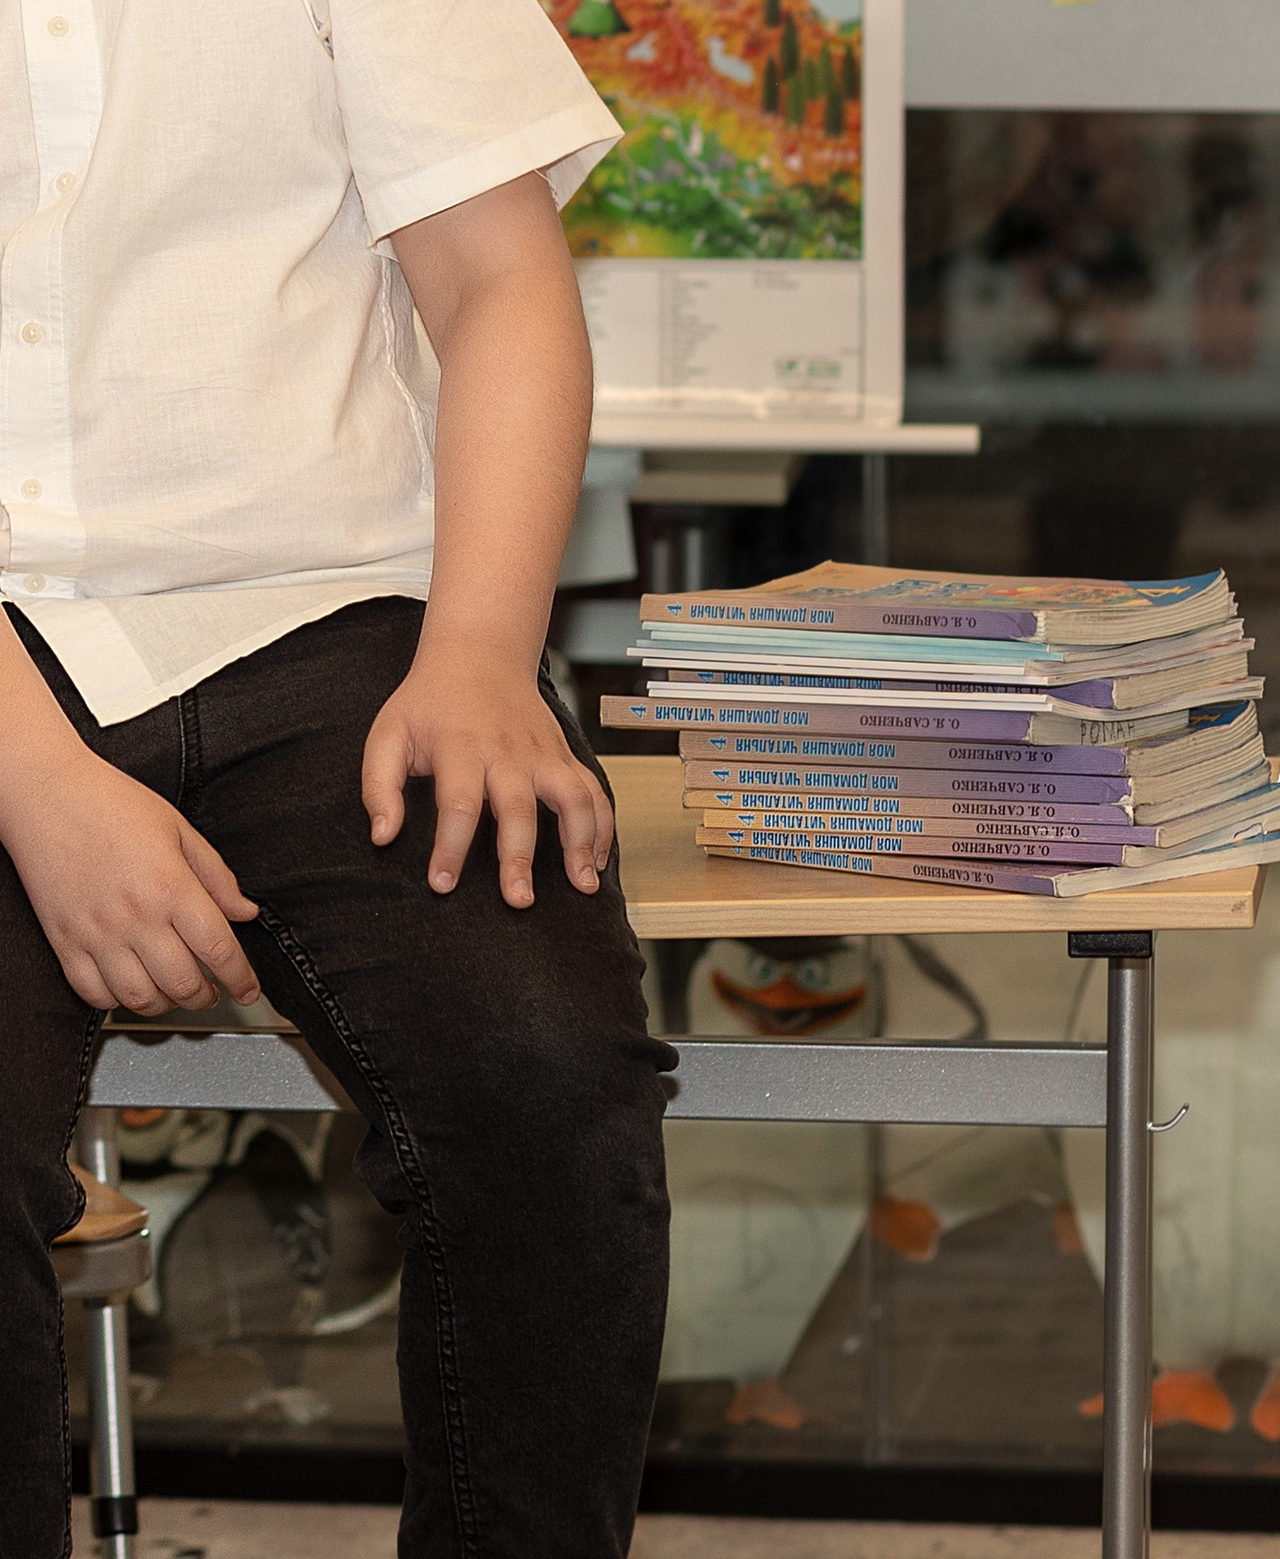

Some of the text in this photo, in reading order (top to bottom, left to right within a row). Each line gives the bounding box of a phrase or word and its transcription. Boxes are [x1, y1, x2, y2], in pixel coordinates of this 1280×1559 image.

[667, 603, 834, 623] МОЯ ДОМАШНЯ ЧИТАЛЬНЯ 4
[882, 613, 976, 628] О. Я. САВЧЕНКО
[629, 705, 808, 725] МОЯ ДОМАШНЯ ЧИТАЛЬНЯ 4
[860, 715, 960, 729] О. Я. САВЧЕНКО
[709, 737, 895, 757] МОЯ ДОМАШНЯ ЧИТАЛЬНЯ 4
[949, 747, 1053, 762] О. Я. САВЧЕНКО
[712, 768, 898, 789] МОЯ ДОМАШНЯ ЧИТАЛЬНЯ 4
[952, 779, 1056, 794] О. Я. САВЧЕНКО
[716, 793, 900, 813] МОЯ ДОМАШНЯ ЧИТАЛЬНЯ 4
[952, 803, 1055, 817] О. Я. САВЧЕНКО
[738, 813, 922, 832] МОЯ ДОМАШНЯ ЧИТАЛЬНЯ 4
[976, 823, 1079, 837] О. Я. САВЧЕНКО
[728, 830, 901, 851] МОЯ ДОМАШНЯ ЧИТАЛЬНЯ 4
[750, 847, 798, 862] ЧИТАЛЬНЯ
[952, 842, 1049, 856] О. Я. САВЧЕНКО
[801, 853, 848, 867] ДОМАШНЯ
[852, 858, 872, 871] МОЯ
[913, 864, 994, 883] О. Я. САВЧЕНКО
